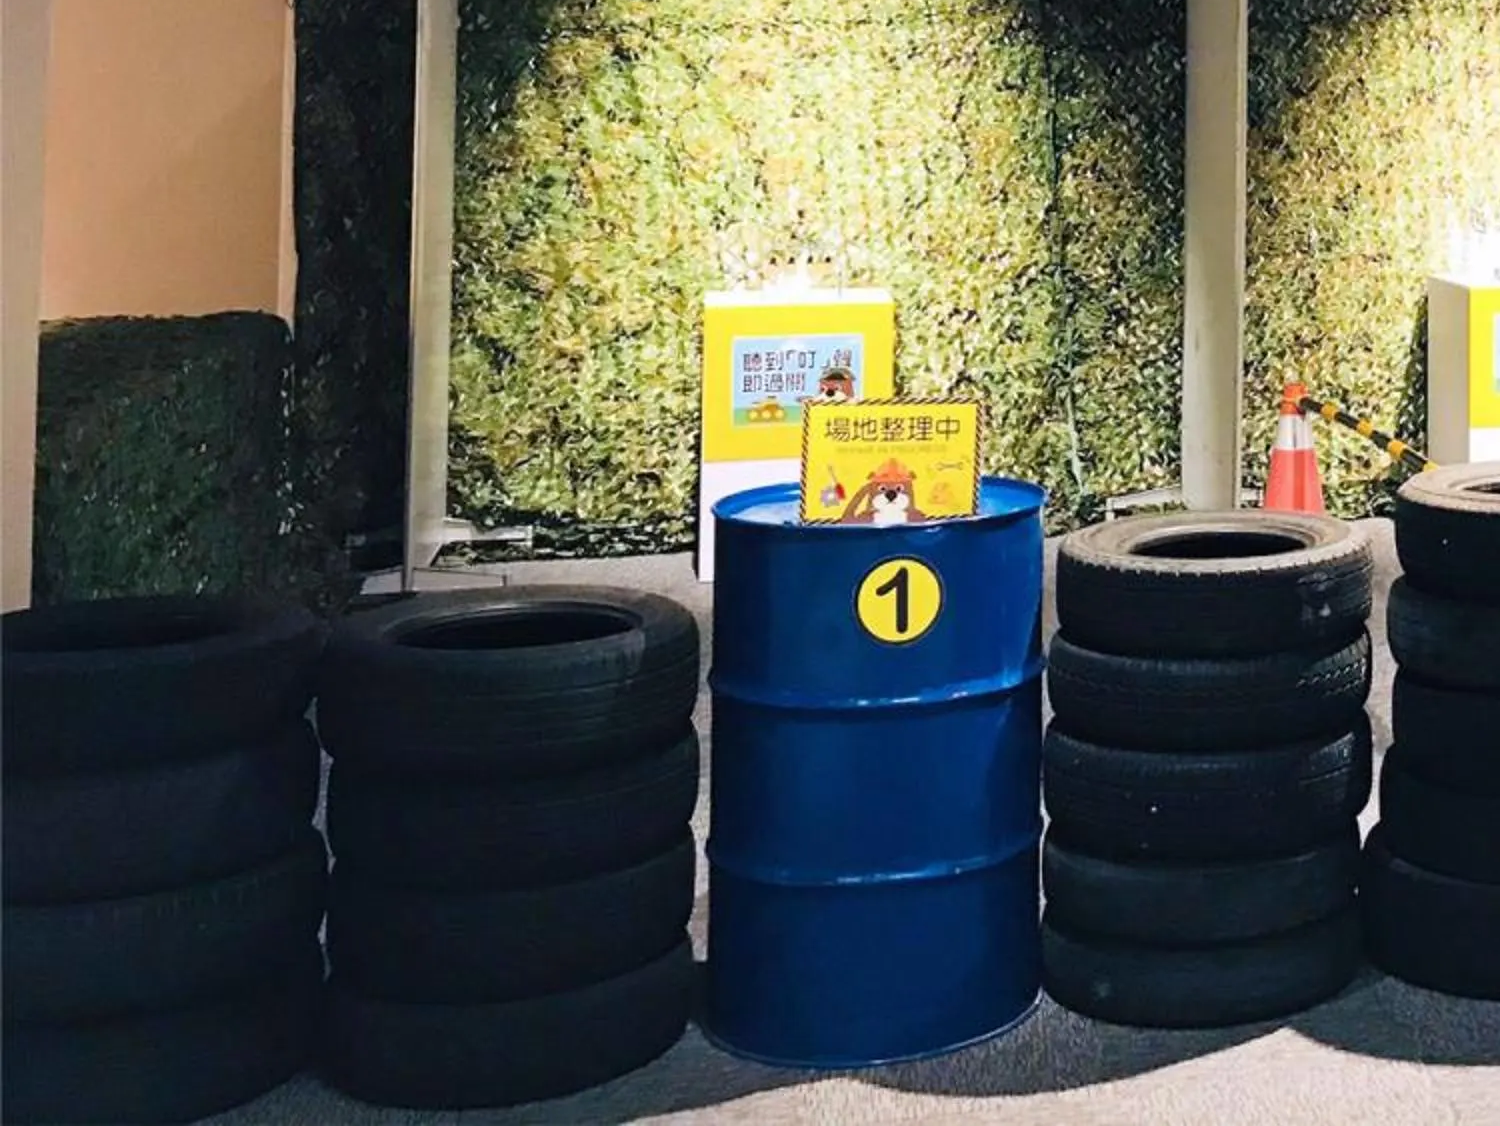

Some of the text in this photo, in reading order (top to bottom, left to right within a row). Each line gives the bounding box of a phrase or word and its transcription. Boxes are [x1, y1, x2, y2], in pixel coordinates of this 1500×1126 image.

[742, 373, 806, 393] 即過關
[824, 415, 961, 443] 場地整理中
[875, 567, 908, 634] 1
